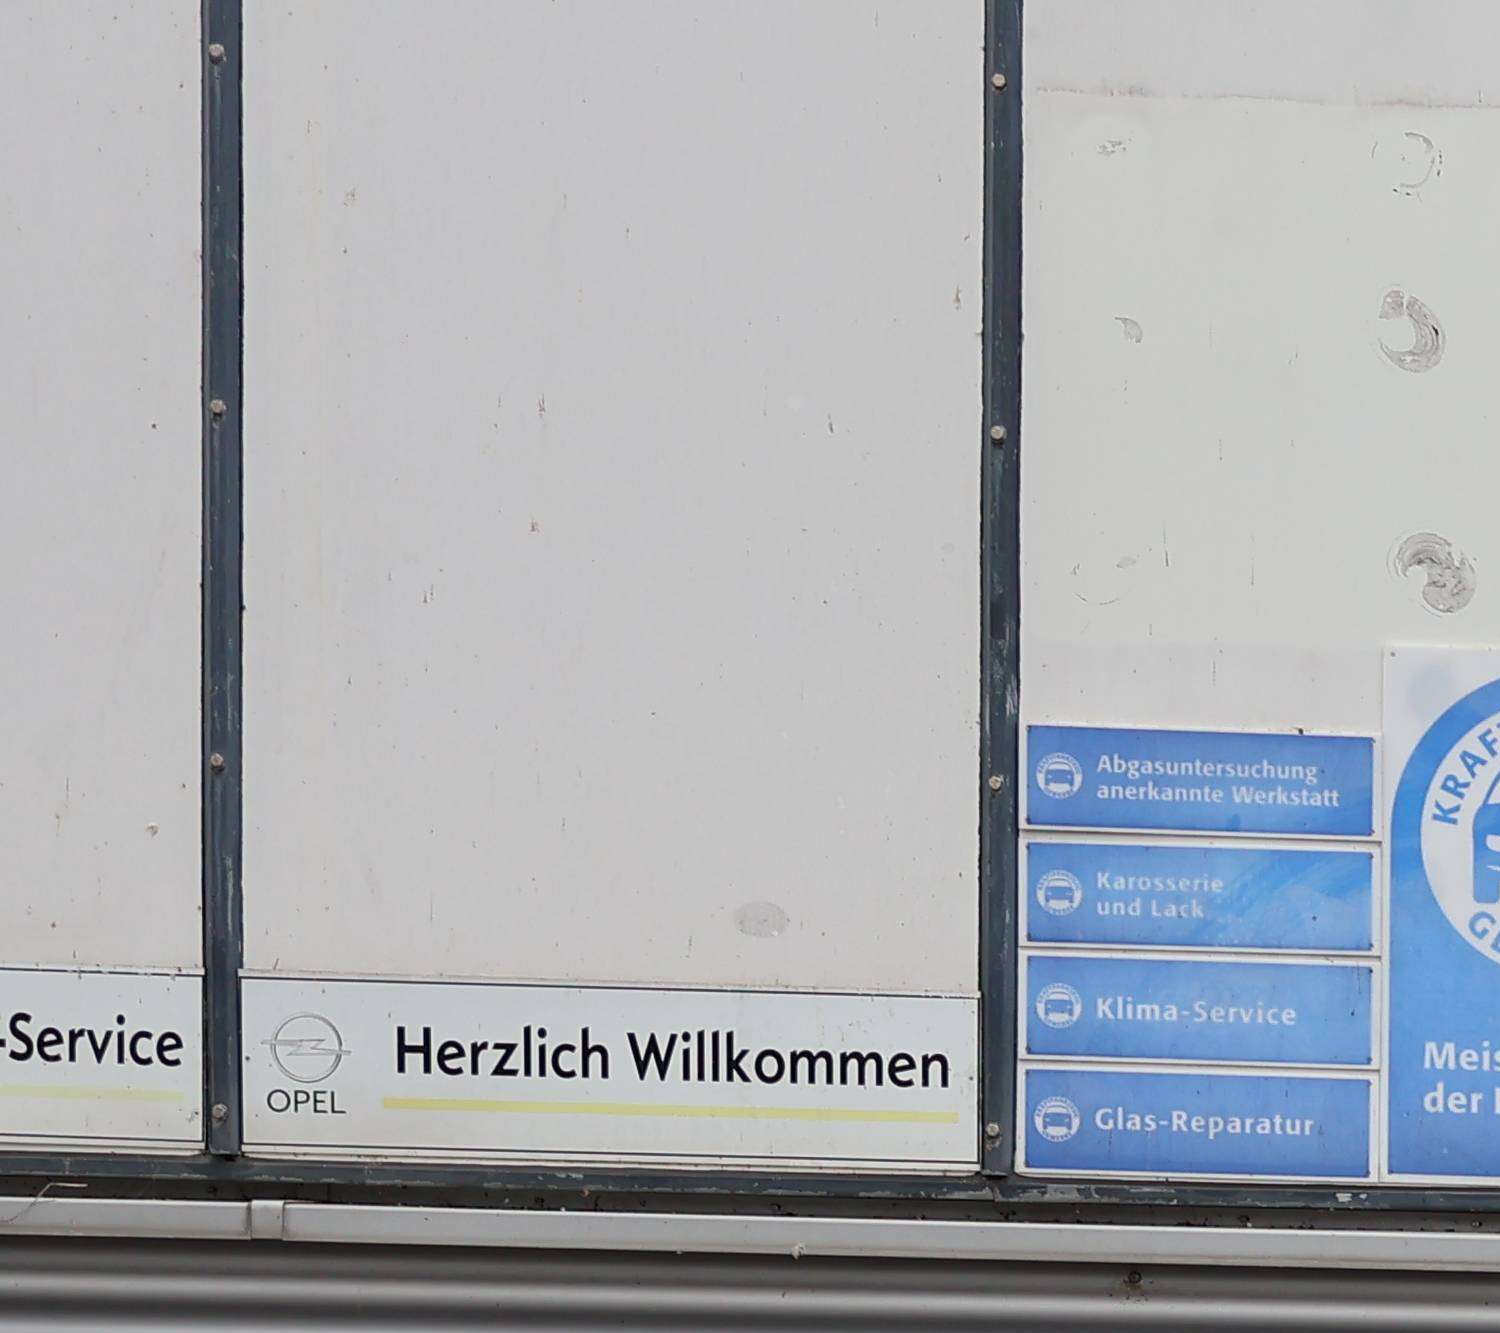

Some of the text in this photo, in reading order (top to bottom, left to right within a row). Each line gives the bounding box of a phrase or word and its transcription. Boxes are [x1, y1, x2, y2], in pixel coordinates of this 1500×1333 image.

[1096, 754, 1319, 785] Abgasuntersuchung
[1096, 781, 1340, 808] anerkannte Werkstatt
[1096, 872, 1224, 894] Karosserie
[1096, 897, 1205, 920] und Lack
[1096, 997, 1297, 1027] Klima-Service
[396, 1025, 951, 1090] Herzlich Willkommen
[266, 1088, 346, 1116] OPEL
[1423, 1086, 1485, 1116] der
[1094, 1107, 1315, 1140] Glas-Reparatur
